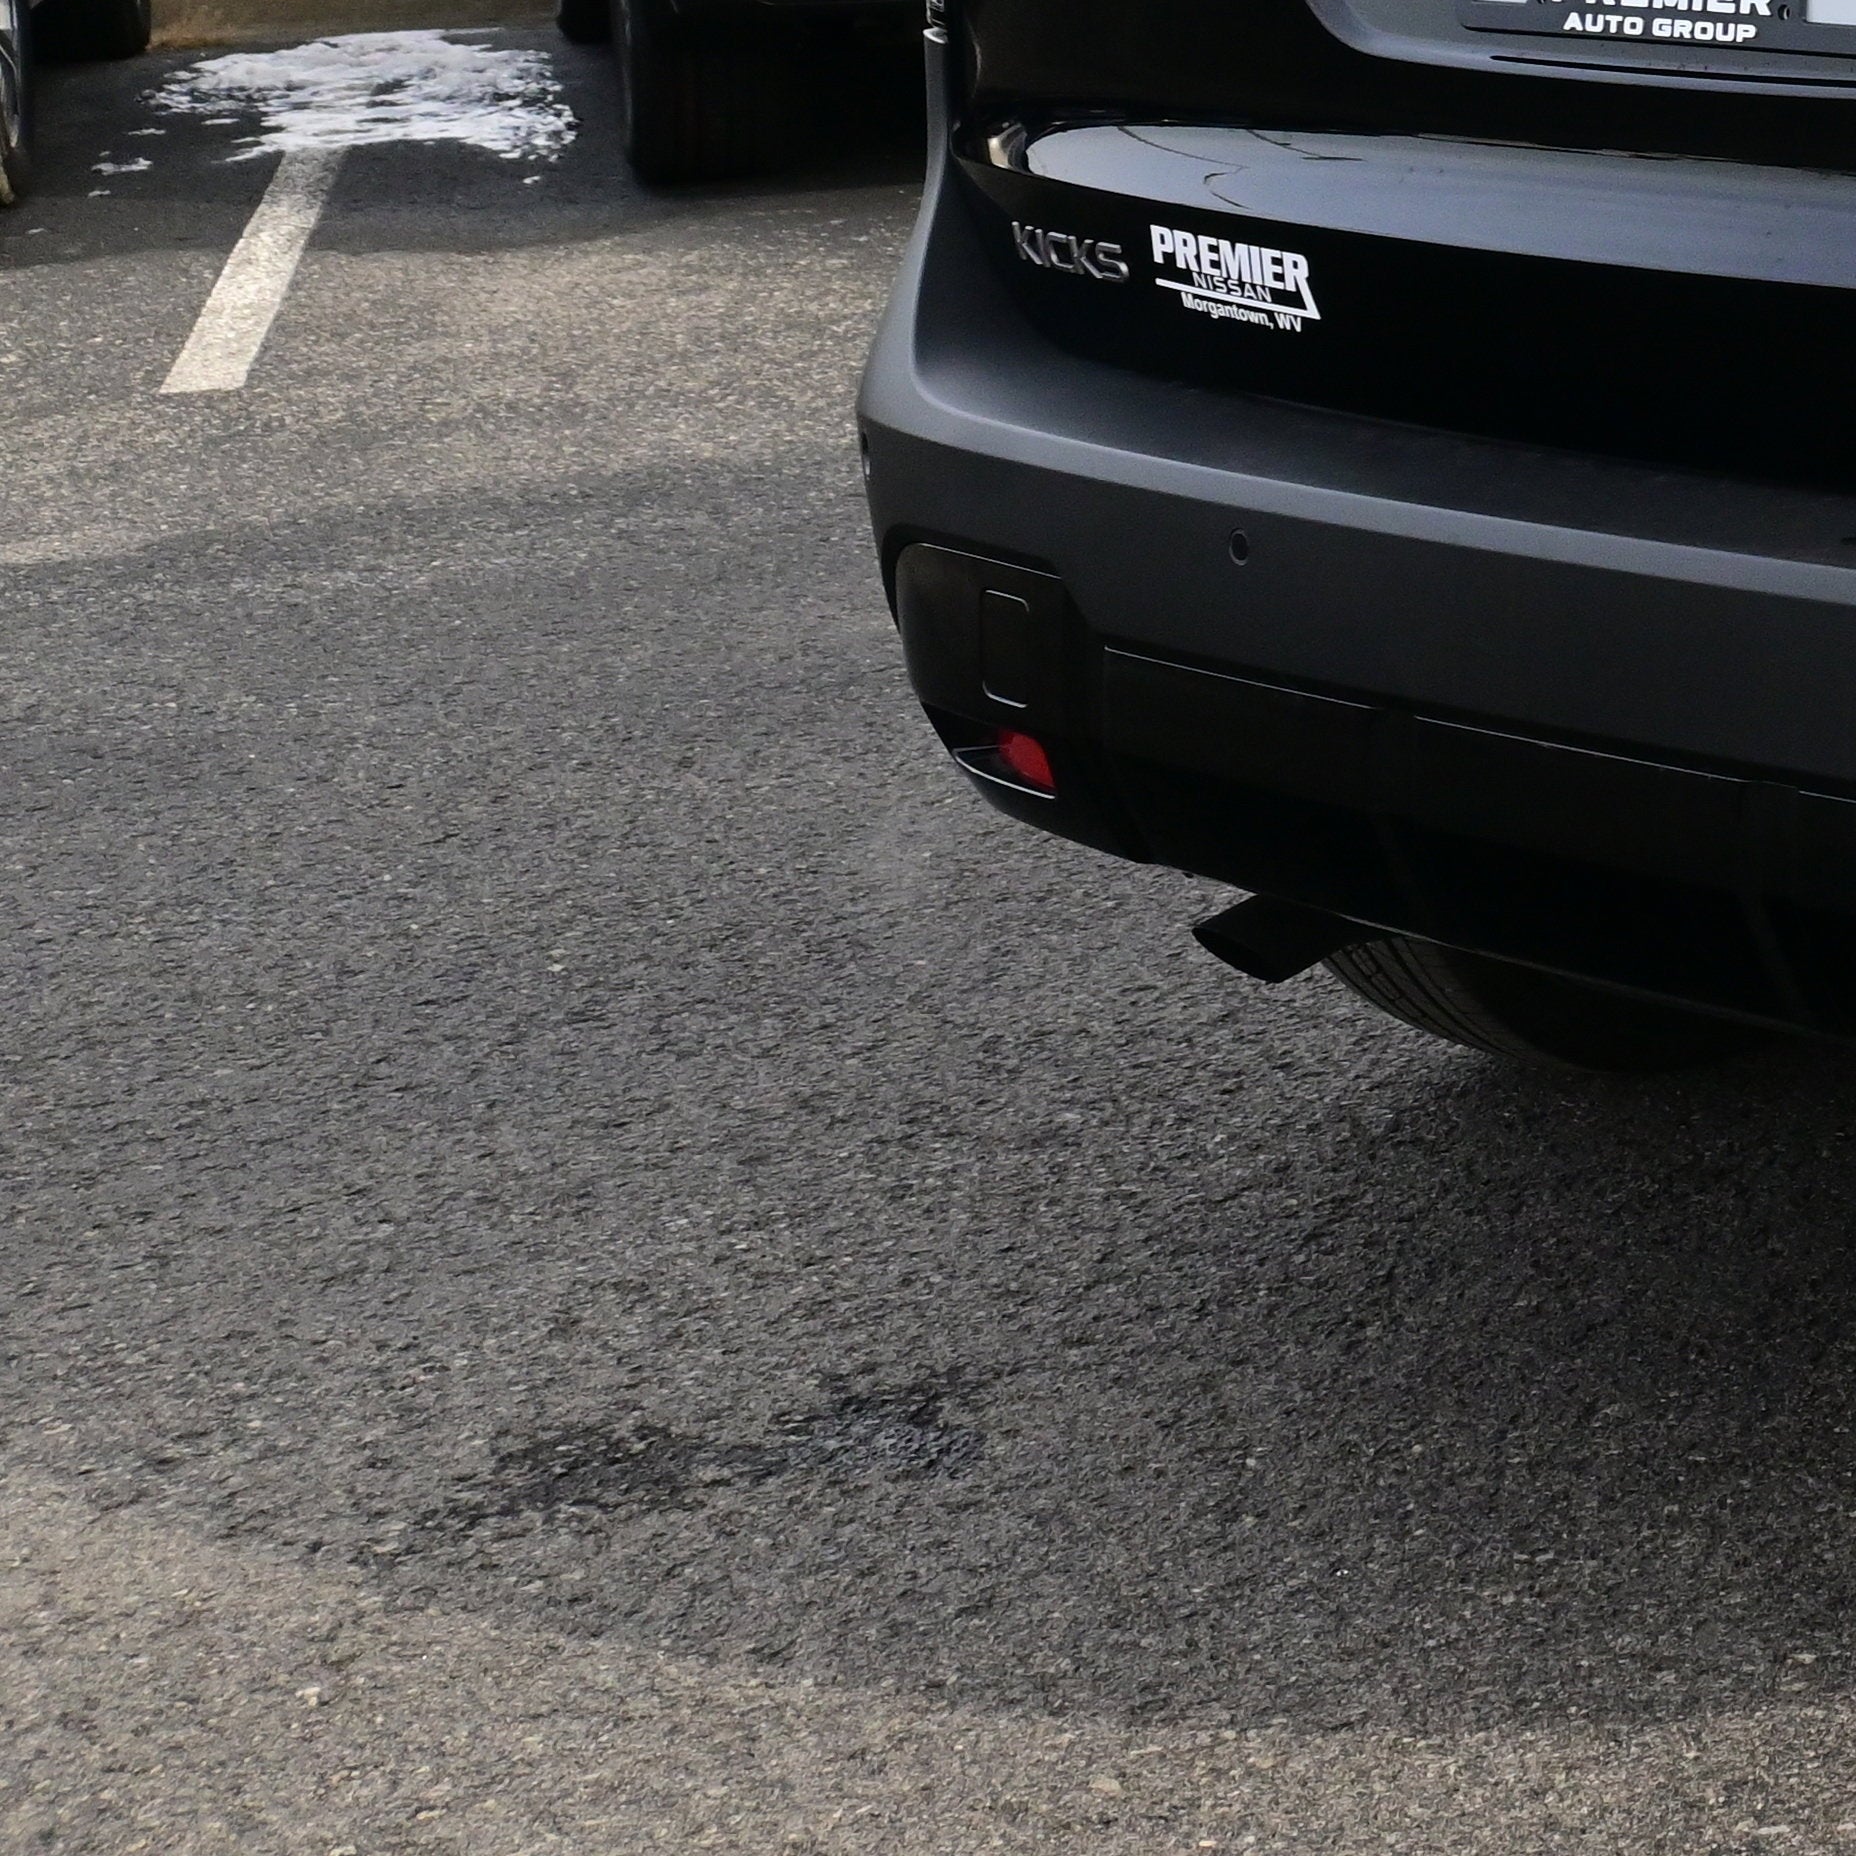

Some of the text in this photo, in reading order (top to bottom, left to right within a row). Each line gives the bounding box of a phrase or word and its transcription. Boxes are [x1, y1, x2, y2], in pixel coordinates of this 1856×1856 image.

[1563, 11, 1757, 43] AUTO GROUP
[1011, 220, 1130, 283] KICKS
[1150, 224, 1312, 293] PREMIER
[1191, 271, 1273, 303] NISSAN
[1180, 291, 1302, 332] Morgantown, WV
